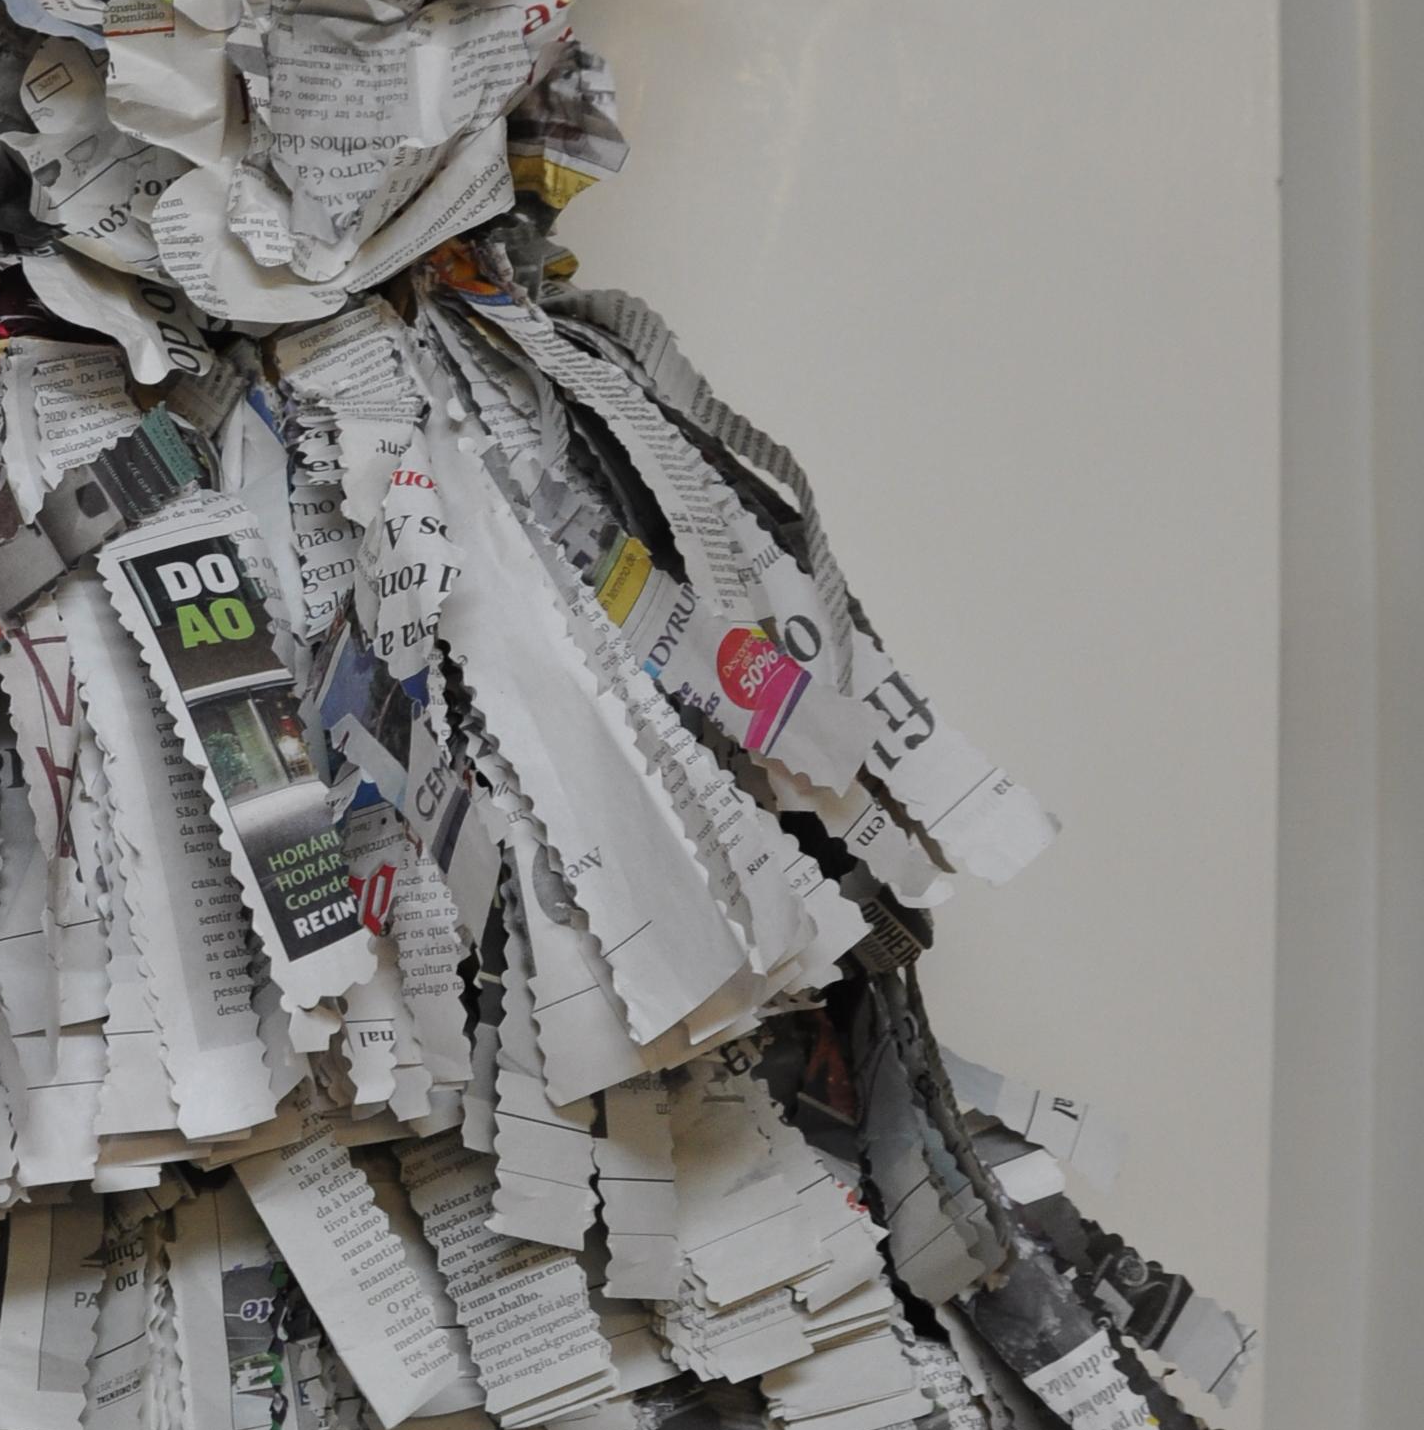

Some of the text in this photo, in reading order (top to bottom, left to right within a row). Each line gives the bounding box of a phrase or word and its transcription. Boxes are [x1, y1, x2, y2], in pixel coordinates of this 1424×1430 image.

[155, 553, 240, 602] DO
[176, 597, 255, 649] AO
[738, 649, 779, 699] 50%
[495, 1309, 537, 1336] Globos
